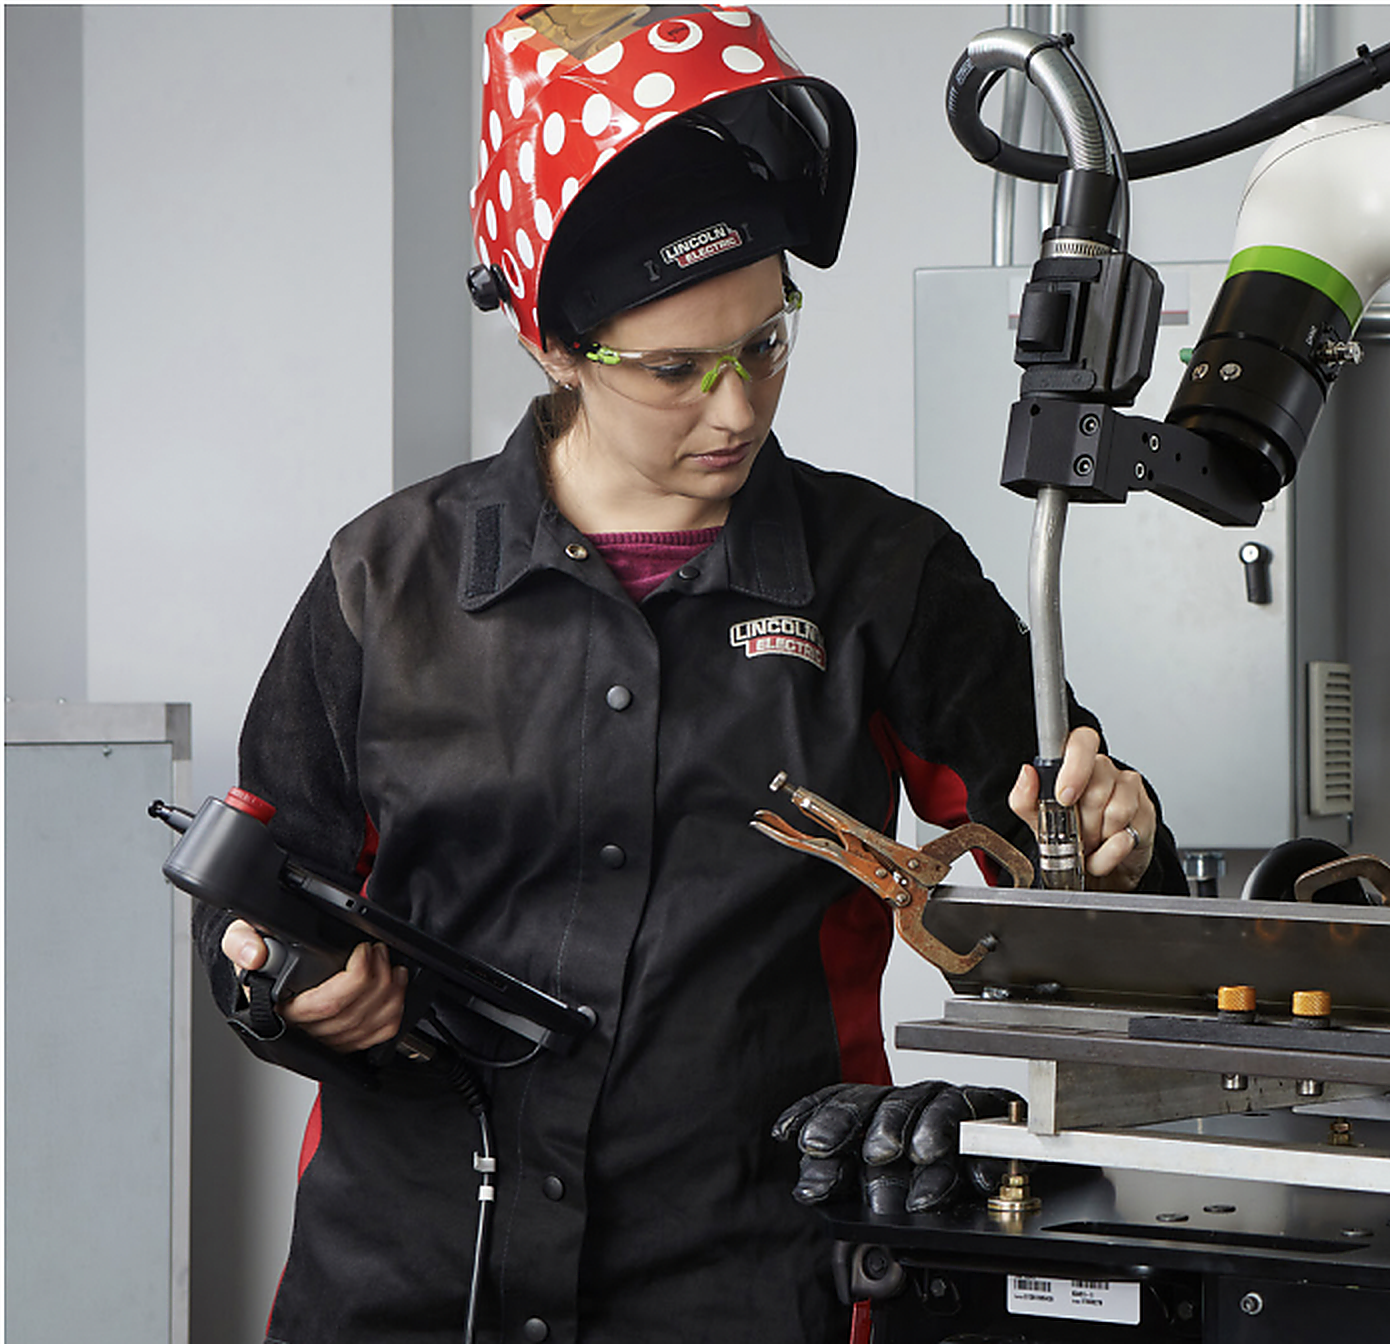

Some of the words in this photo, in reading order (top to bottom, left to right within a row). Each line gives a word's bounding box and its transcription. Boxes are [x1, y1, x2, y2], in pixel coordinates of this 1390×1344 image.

[665, 227, 727, 259] LINCOLN
[685, 236, 737, 262] ELECTRIC
[735, 618, 822, 645] LINCOLN
[755, 636, 823, 663] ELECTRIC
